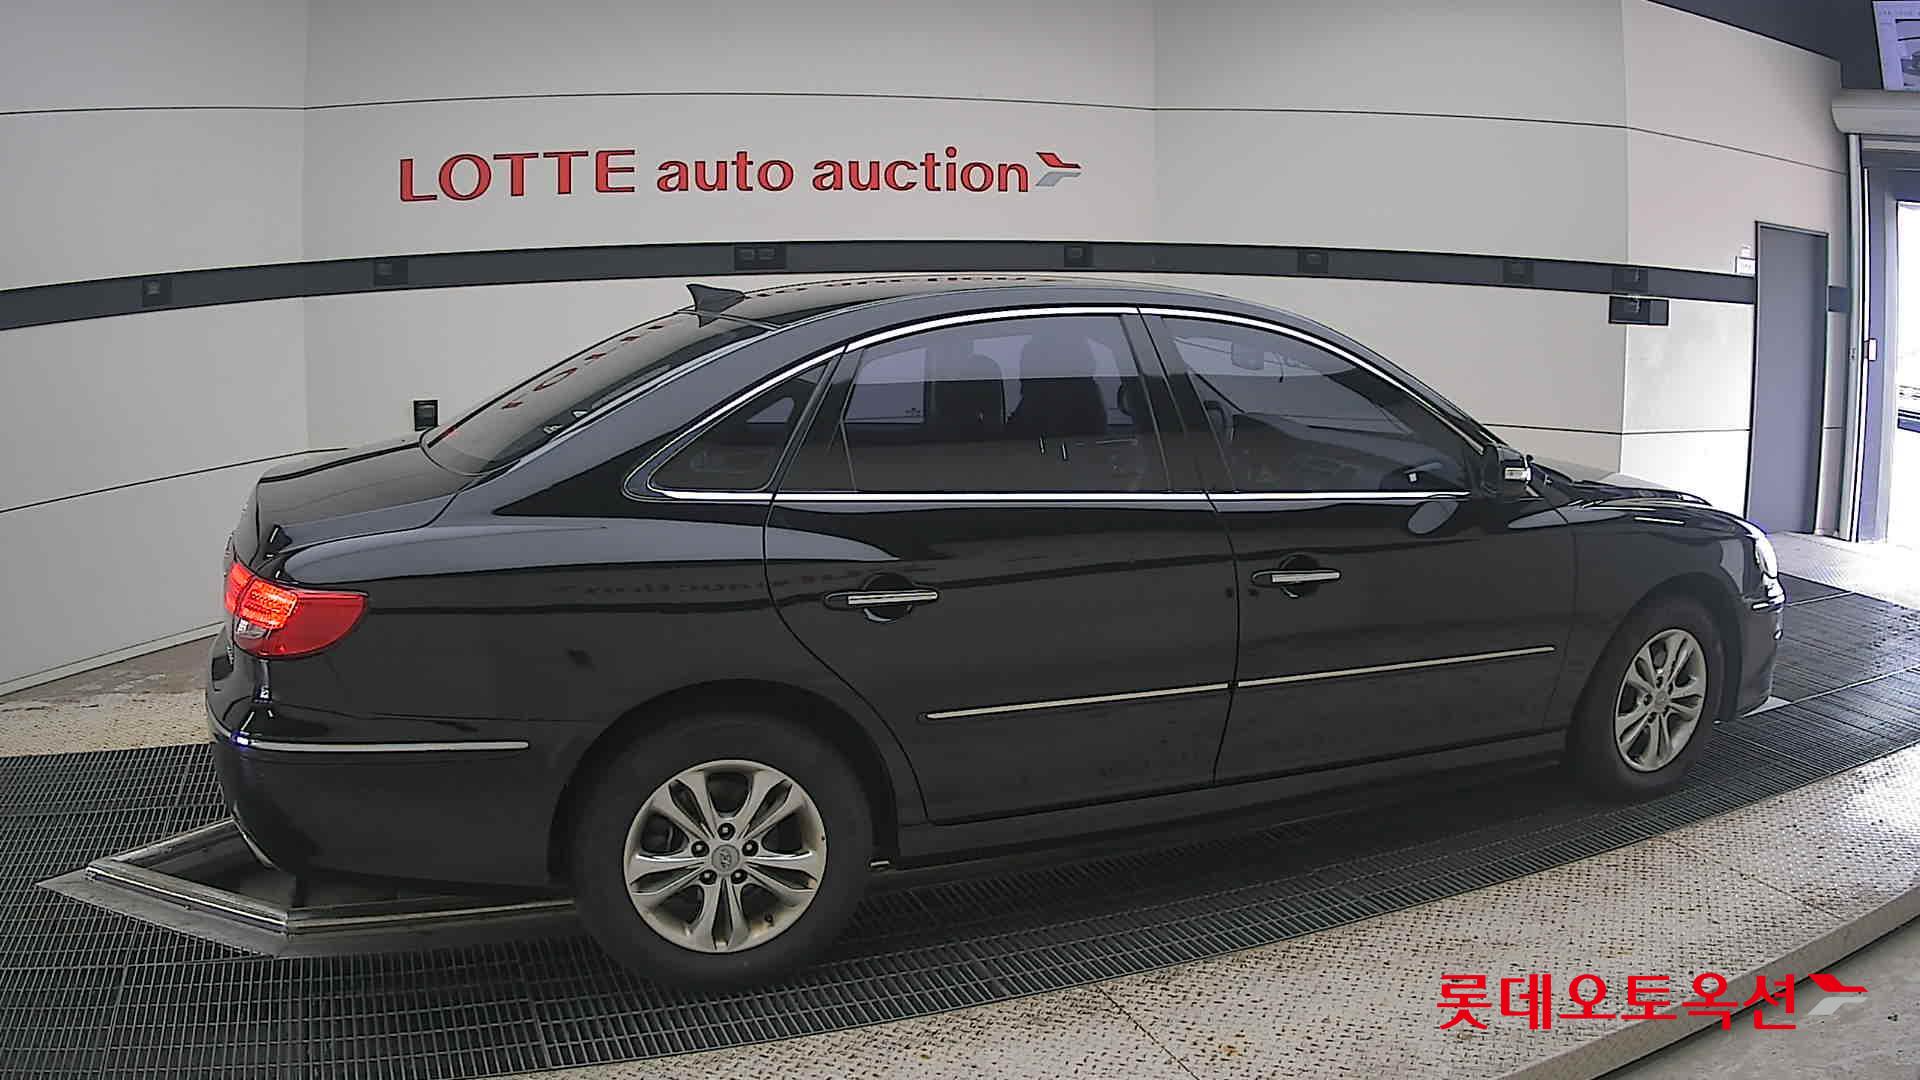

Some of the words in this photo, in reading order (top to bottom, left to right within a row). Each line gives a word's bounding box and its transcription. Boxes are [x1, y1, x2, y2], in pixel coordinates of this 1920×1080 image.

[399, 149, 636, 204] LOTTE
[656, 150, 796, 193] auto
[813, 145, 1031, 194] auction
